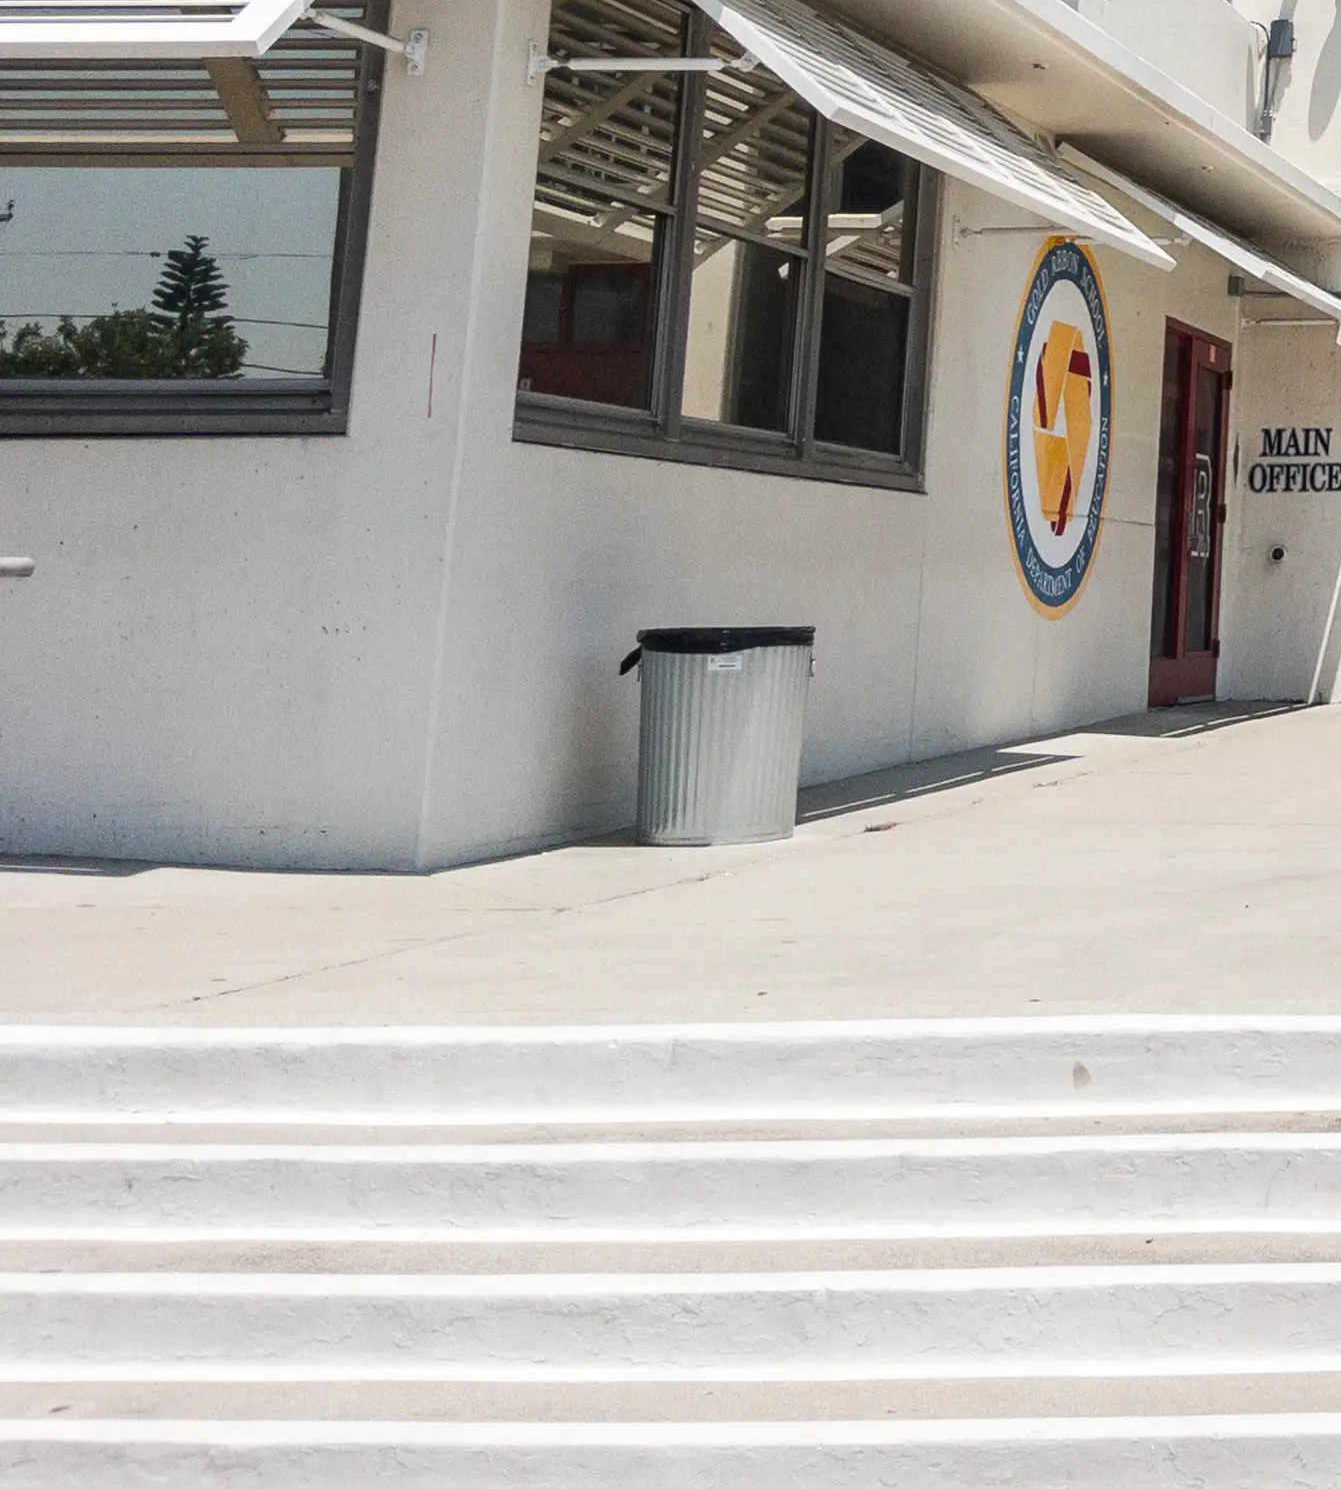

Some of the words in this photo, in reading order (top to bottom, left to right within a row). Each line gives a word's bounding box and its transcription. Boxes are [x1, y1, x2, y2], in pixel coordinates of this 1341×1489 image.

[1026, 268, 1050, 325] GOLD
[1259, 427, 1333, 458] MAIN
[1009, 395, 1025, 546] CALIFORNIA
[1075, 546, 1087, 574] OF
